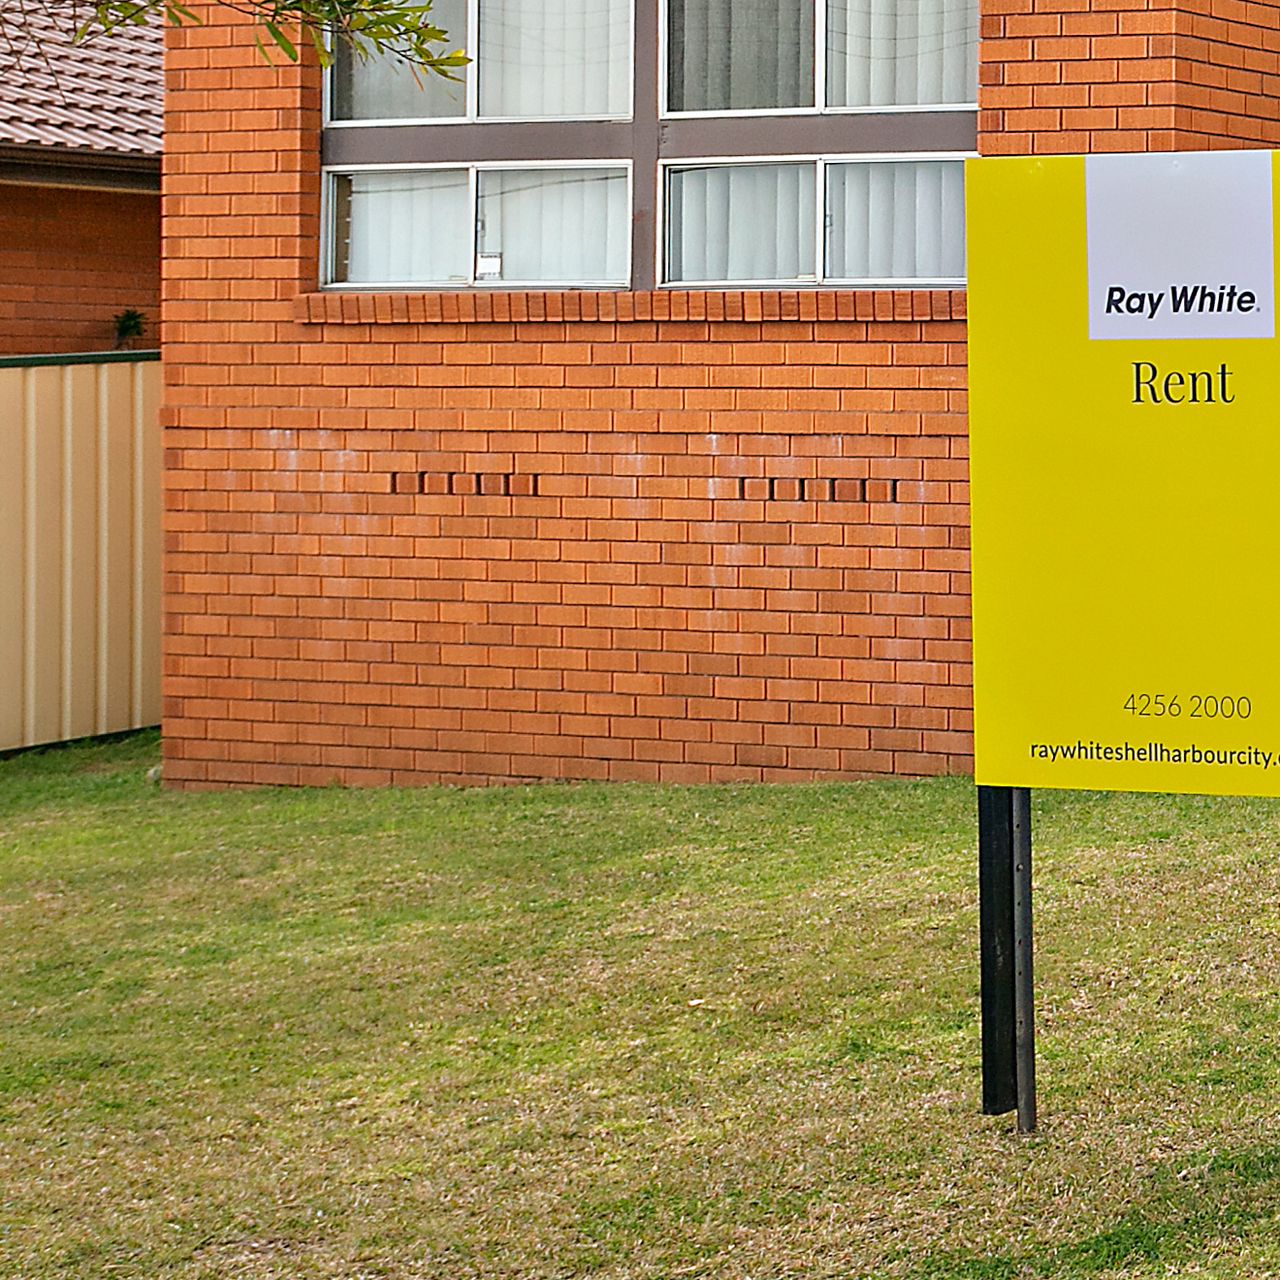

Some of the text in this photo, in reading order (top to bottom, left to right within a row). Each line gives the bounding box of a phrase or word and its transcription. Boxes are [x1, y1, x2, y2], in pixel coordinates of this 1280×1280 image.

[1105, 285, 1256, 319] Ray White
[1131, 361, 1236, 404] Rent
[1123, 693, 1252, 719] 4256 2000
